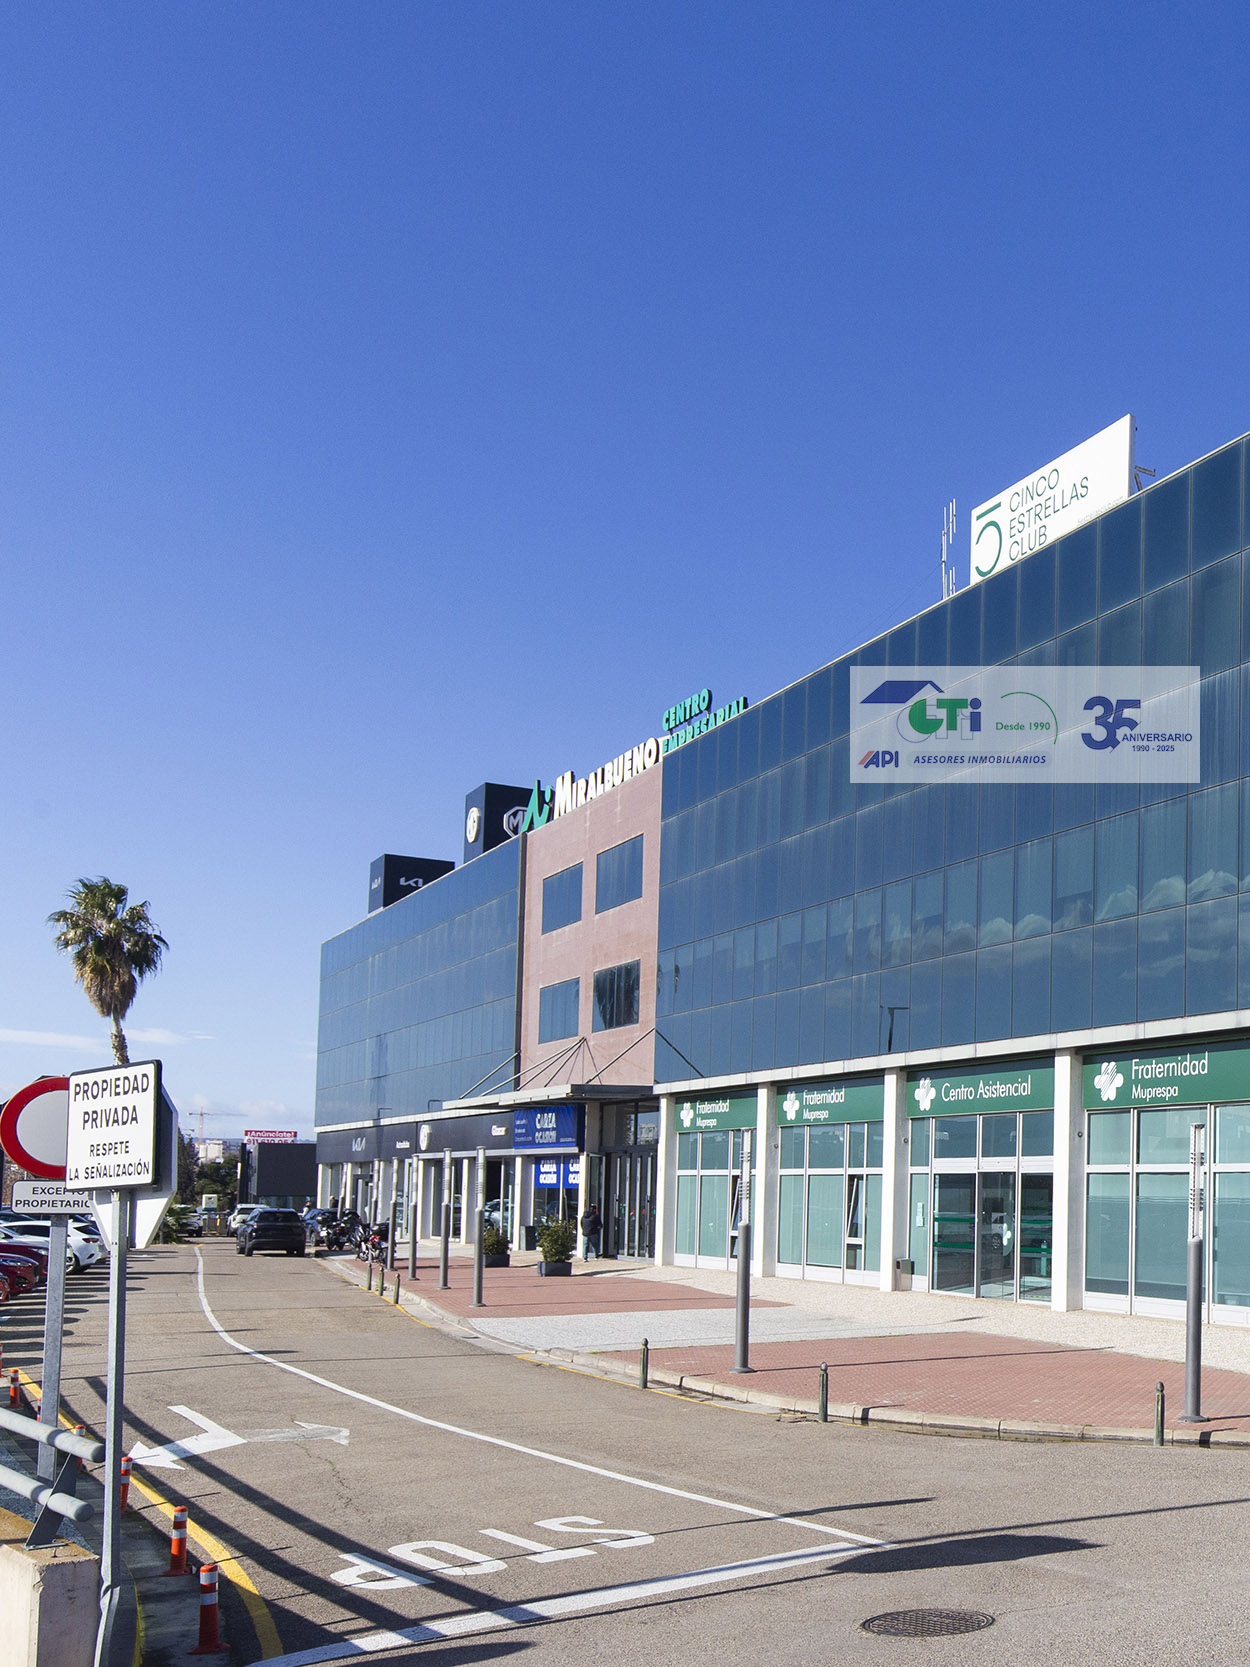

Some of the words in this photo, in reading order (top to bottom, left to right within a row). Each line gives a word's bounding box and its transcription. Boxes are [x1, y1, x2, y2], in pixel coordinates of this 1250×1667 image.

[1009, 468, 1059, 512] CINCO
[1009, 477, 1089, 538] ESTRELLAS
[975, 501, 1002, 577] 5
[1009, 525, 1047, 561] CLUB
[662, 688, 711, 731] CENTRO
[662, 696, 746, 754] EMPRESARIAL
[1131, 1051, 1209, 1080] Fraternidad
[74, 1073, 149, 1102] PROPIEDAD
[802, 1086, 845, 1105] Fraternidad
[941, 1082, 975, 1102] Centro
[977, 1075, 1031, 1099] Asistencial
[1131, 1085, 1178, 1103] Muprespa
[82, 1104, 139, 1130] PRIVADA
[696, 1098, 730, 1114] Fraternidad
[803, 1109, 829, 1122] Muprespa
[89, 1140, 130, 1157] RESPETE
[69, 1167, 79, 1181] LA
[84, 1158, 150, 1180] SEÑALIZACIÓN
[330, 1515, 655, 1590] STOP
